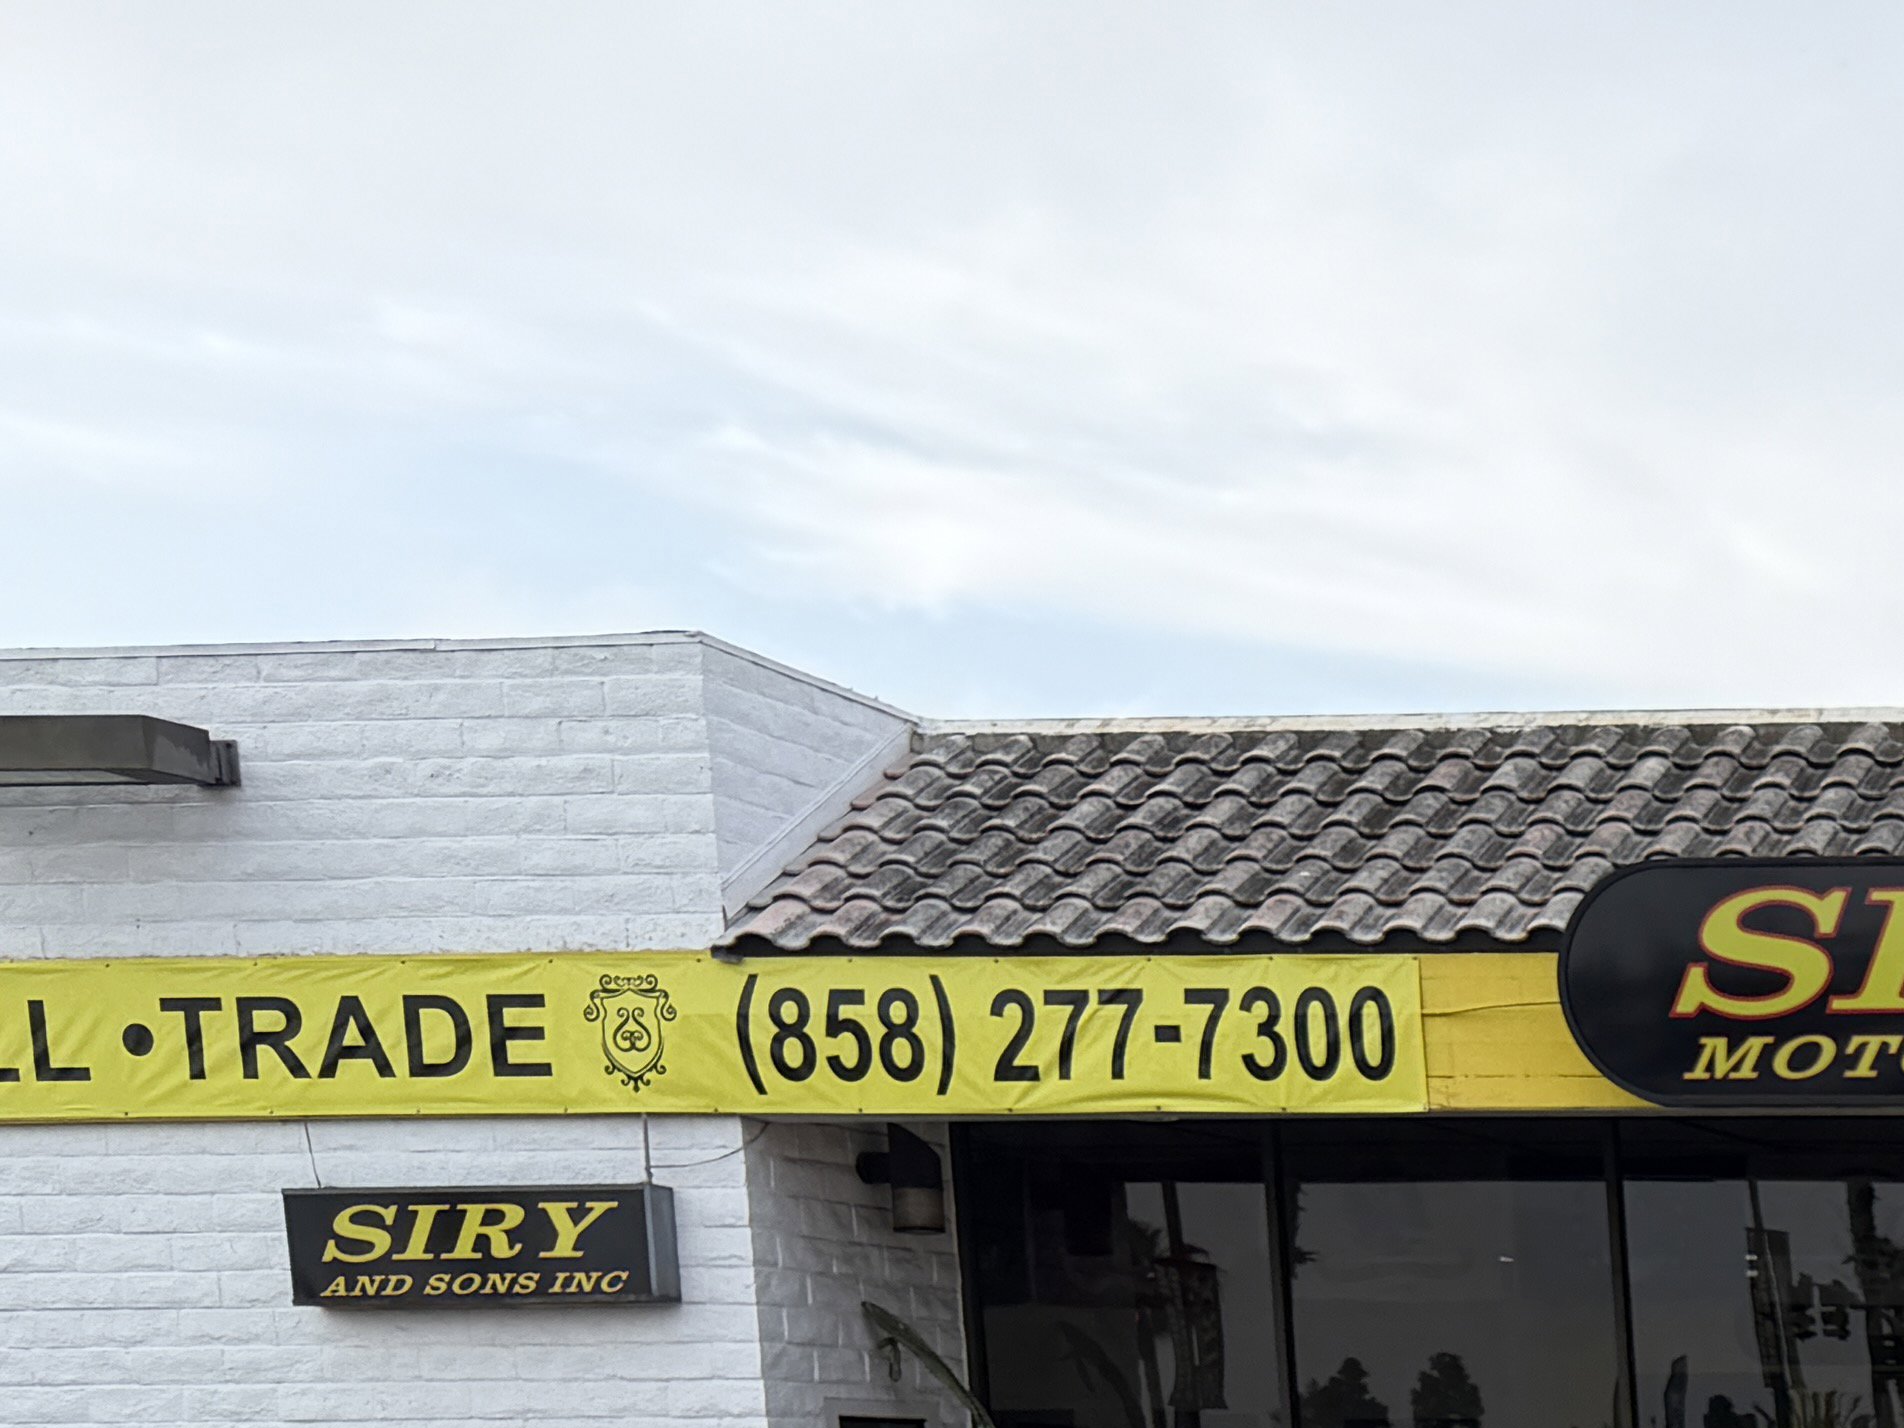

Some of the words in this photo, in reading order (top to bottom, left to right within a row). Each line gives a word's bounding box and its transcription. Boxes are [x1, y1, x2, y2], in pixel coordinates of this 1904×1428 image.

[735, 973, 956, 1096] (858)
[989, 985, 1396, 1083] 277-7300
[321, 1200, 619, 1263] SIRY
[319, 1274, 413, 1297] AND
[423, 1271, 541, 1295] SONS
[548, 1270, 630, 1293] INC
